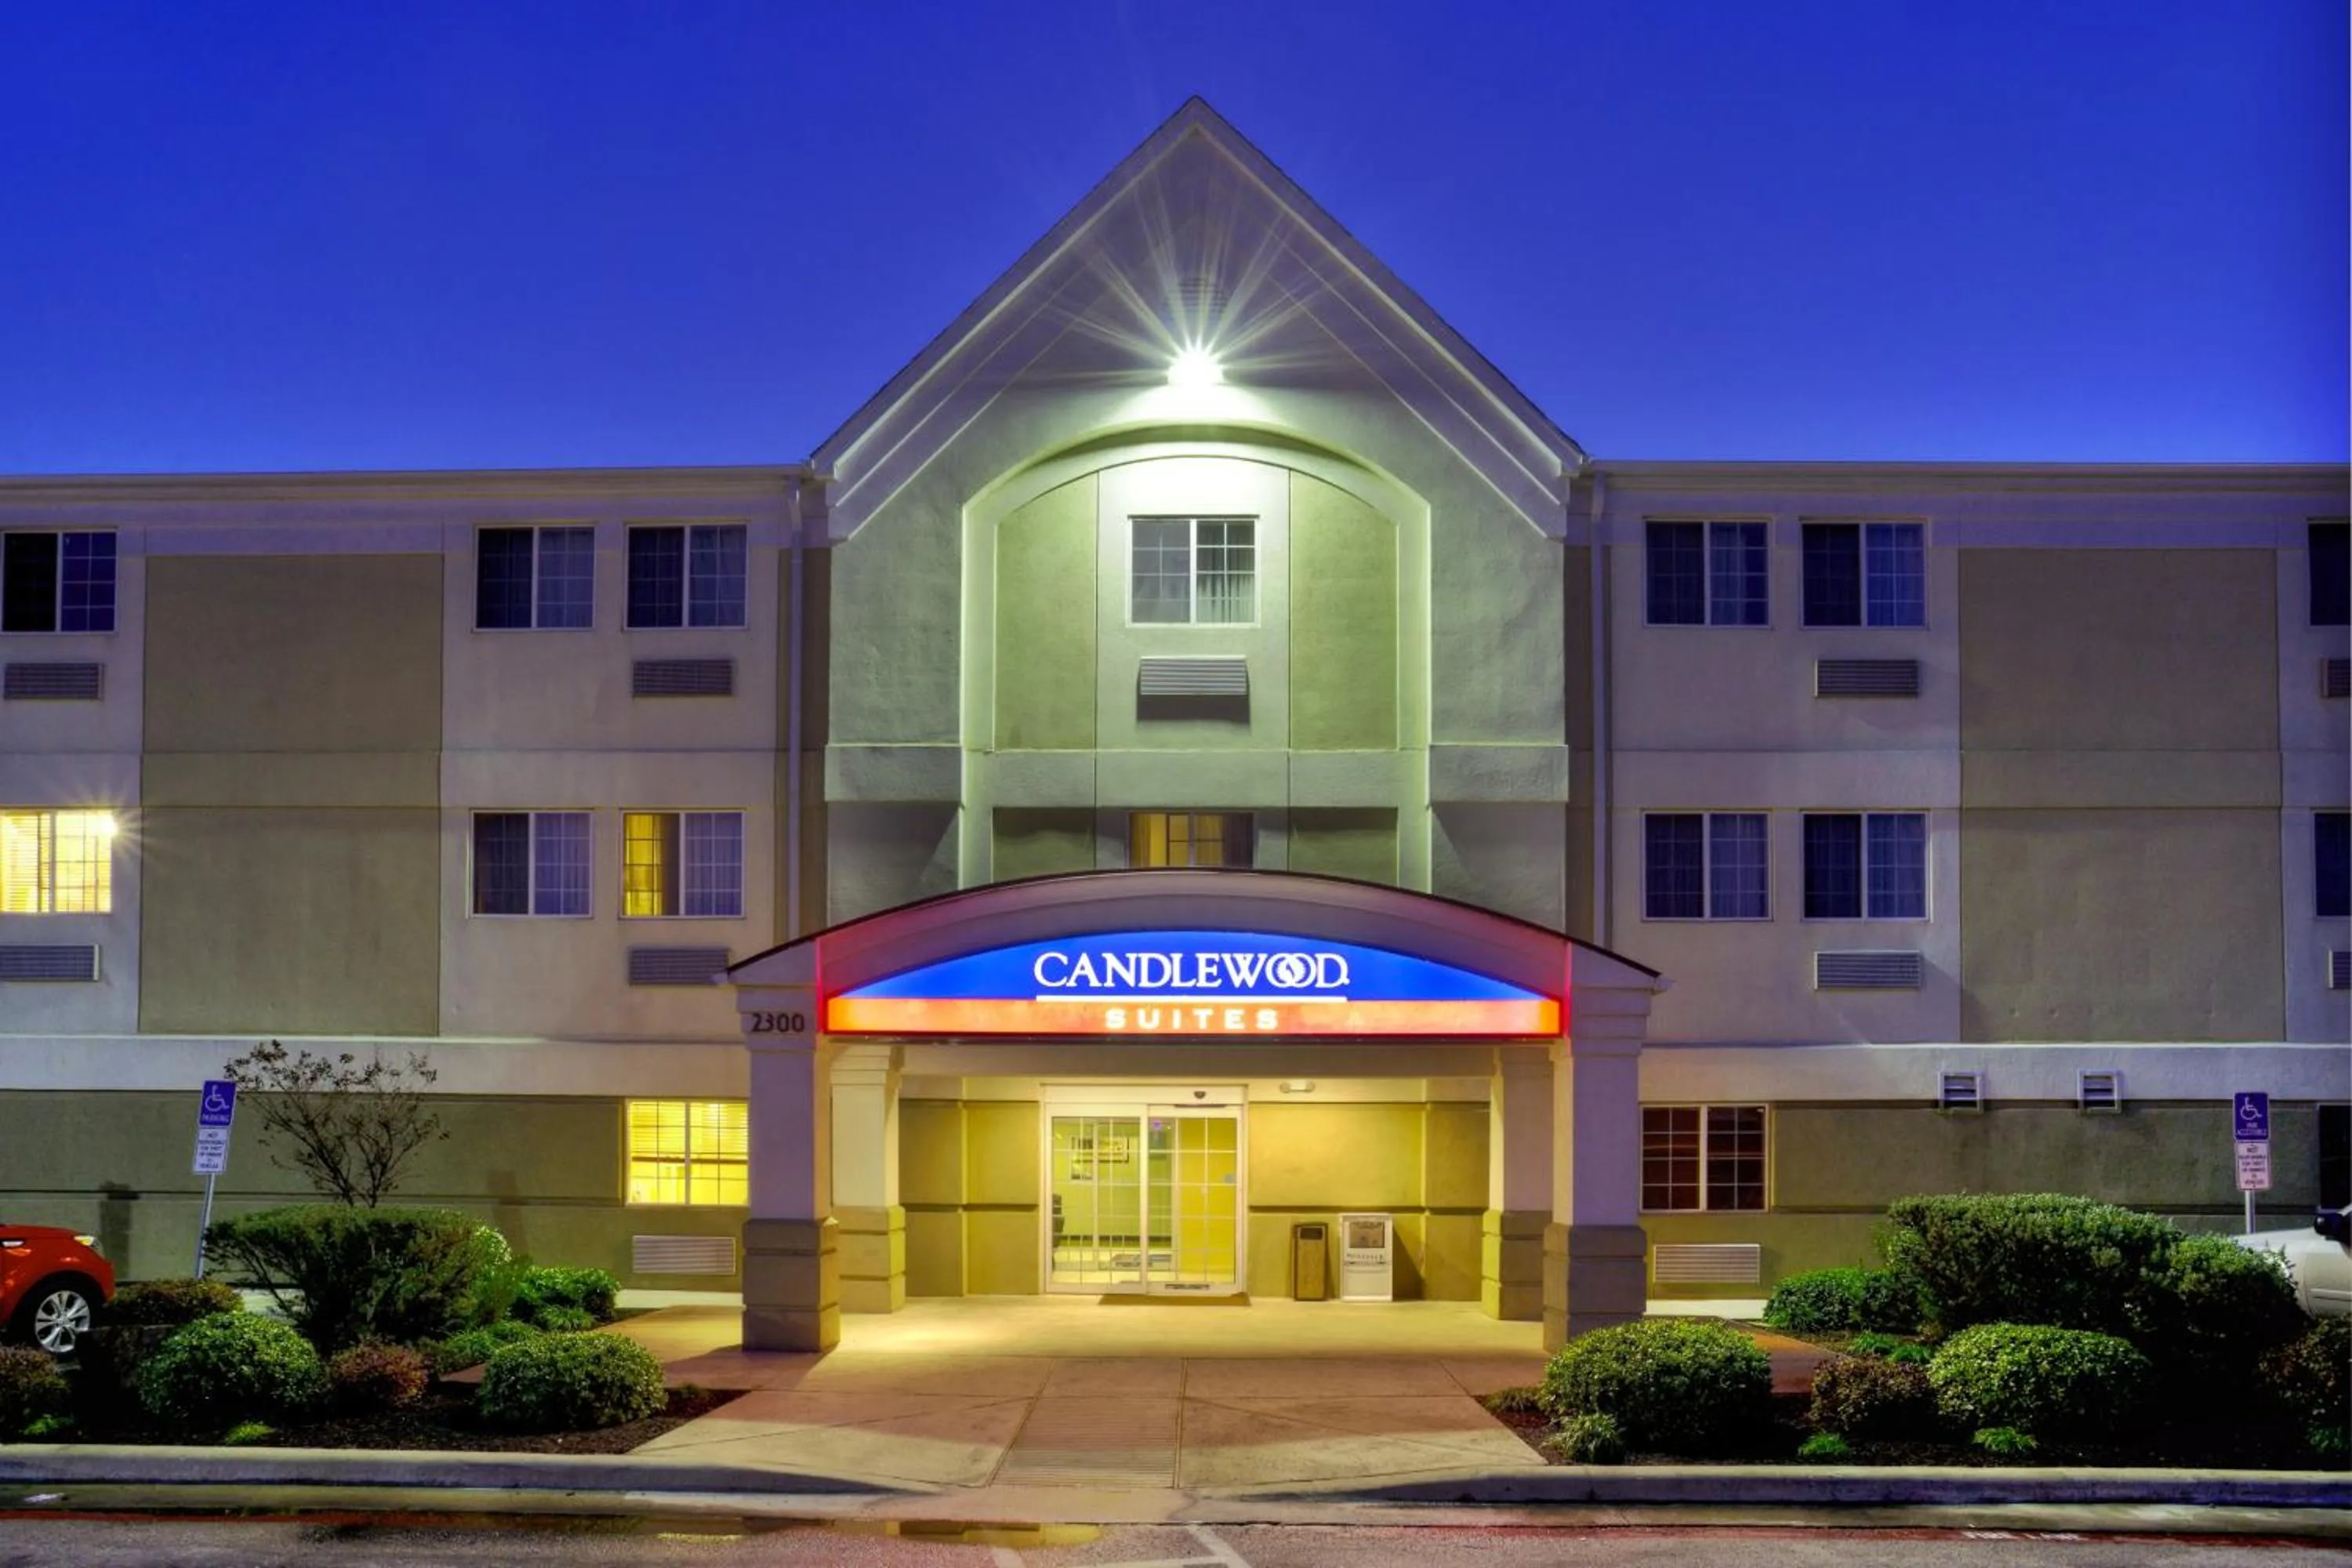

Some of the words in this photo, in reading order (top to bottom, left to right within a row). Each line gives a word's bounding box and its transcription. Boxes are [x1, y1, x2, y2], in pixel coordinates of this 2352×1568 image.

[1033, 952, 1349, 989] CANDLEWOOD
[752, 1013, 804, 1033] 2300
[1105, 1008, 1279, 1029] SUITES
